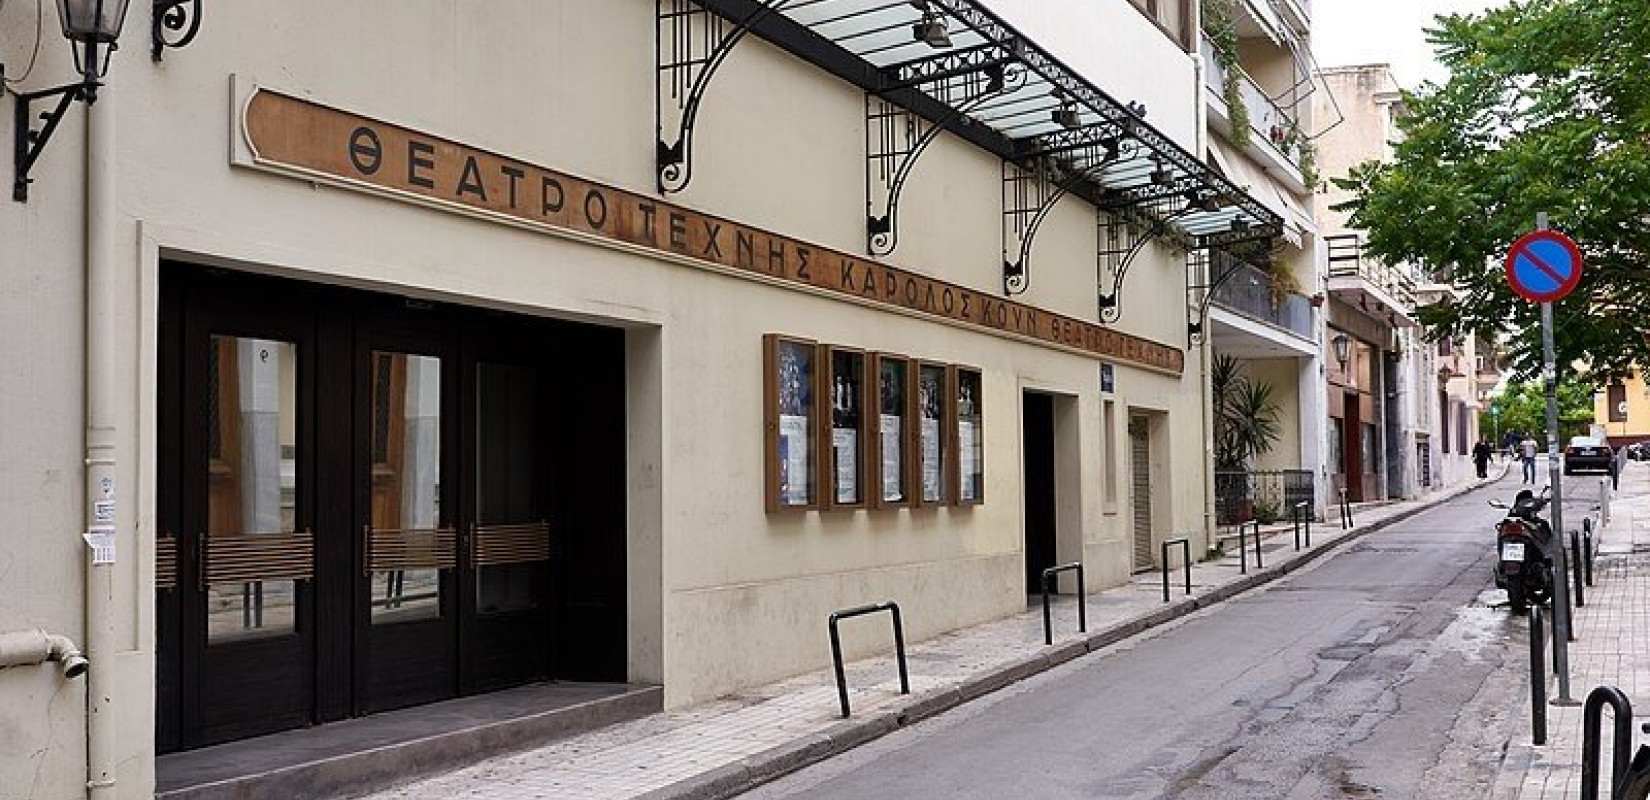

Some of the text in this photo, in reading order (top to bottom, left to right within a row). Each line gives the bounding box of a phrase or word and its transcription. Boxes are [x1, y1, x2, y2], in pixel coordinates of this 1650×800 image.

[349, 127, 606, 229] ΘΕΑΤΡΟ
[639, 203, 811, 280] ΤΕΧΝΗΣ
[841, 258, 970, 318] ΚΑΡΟΛΟΣ
[982, 297, 1037, 331] ΚΟΥΝ
